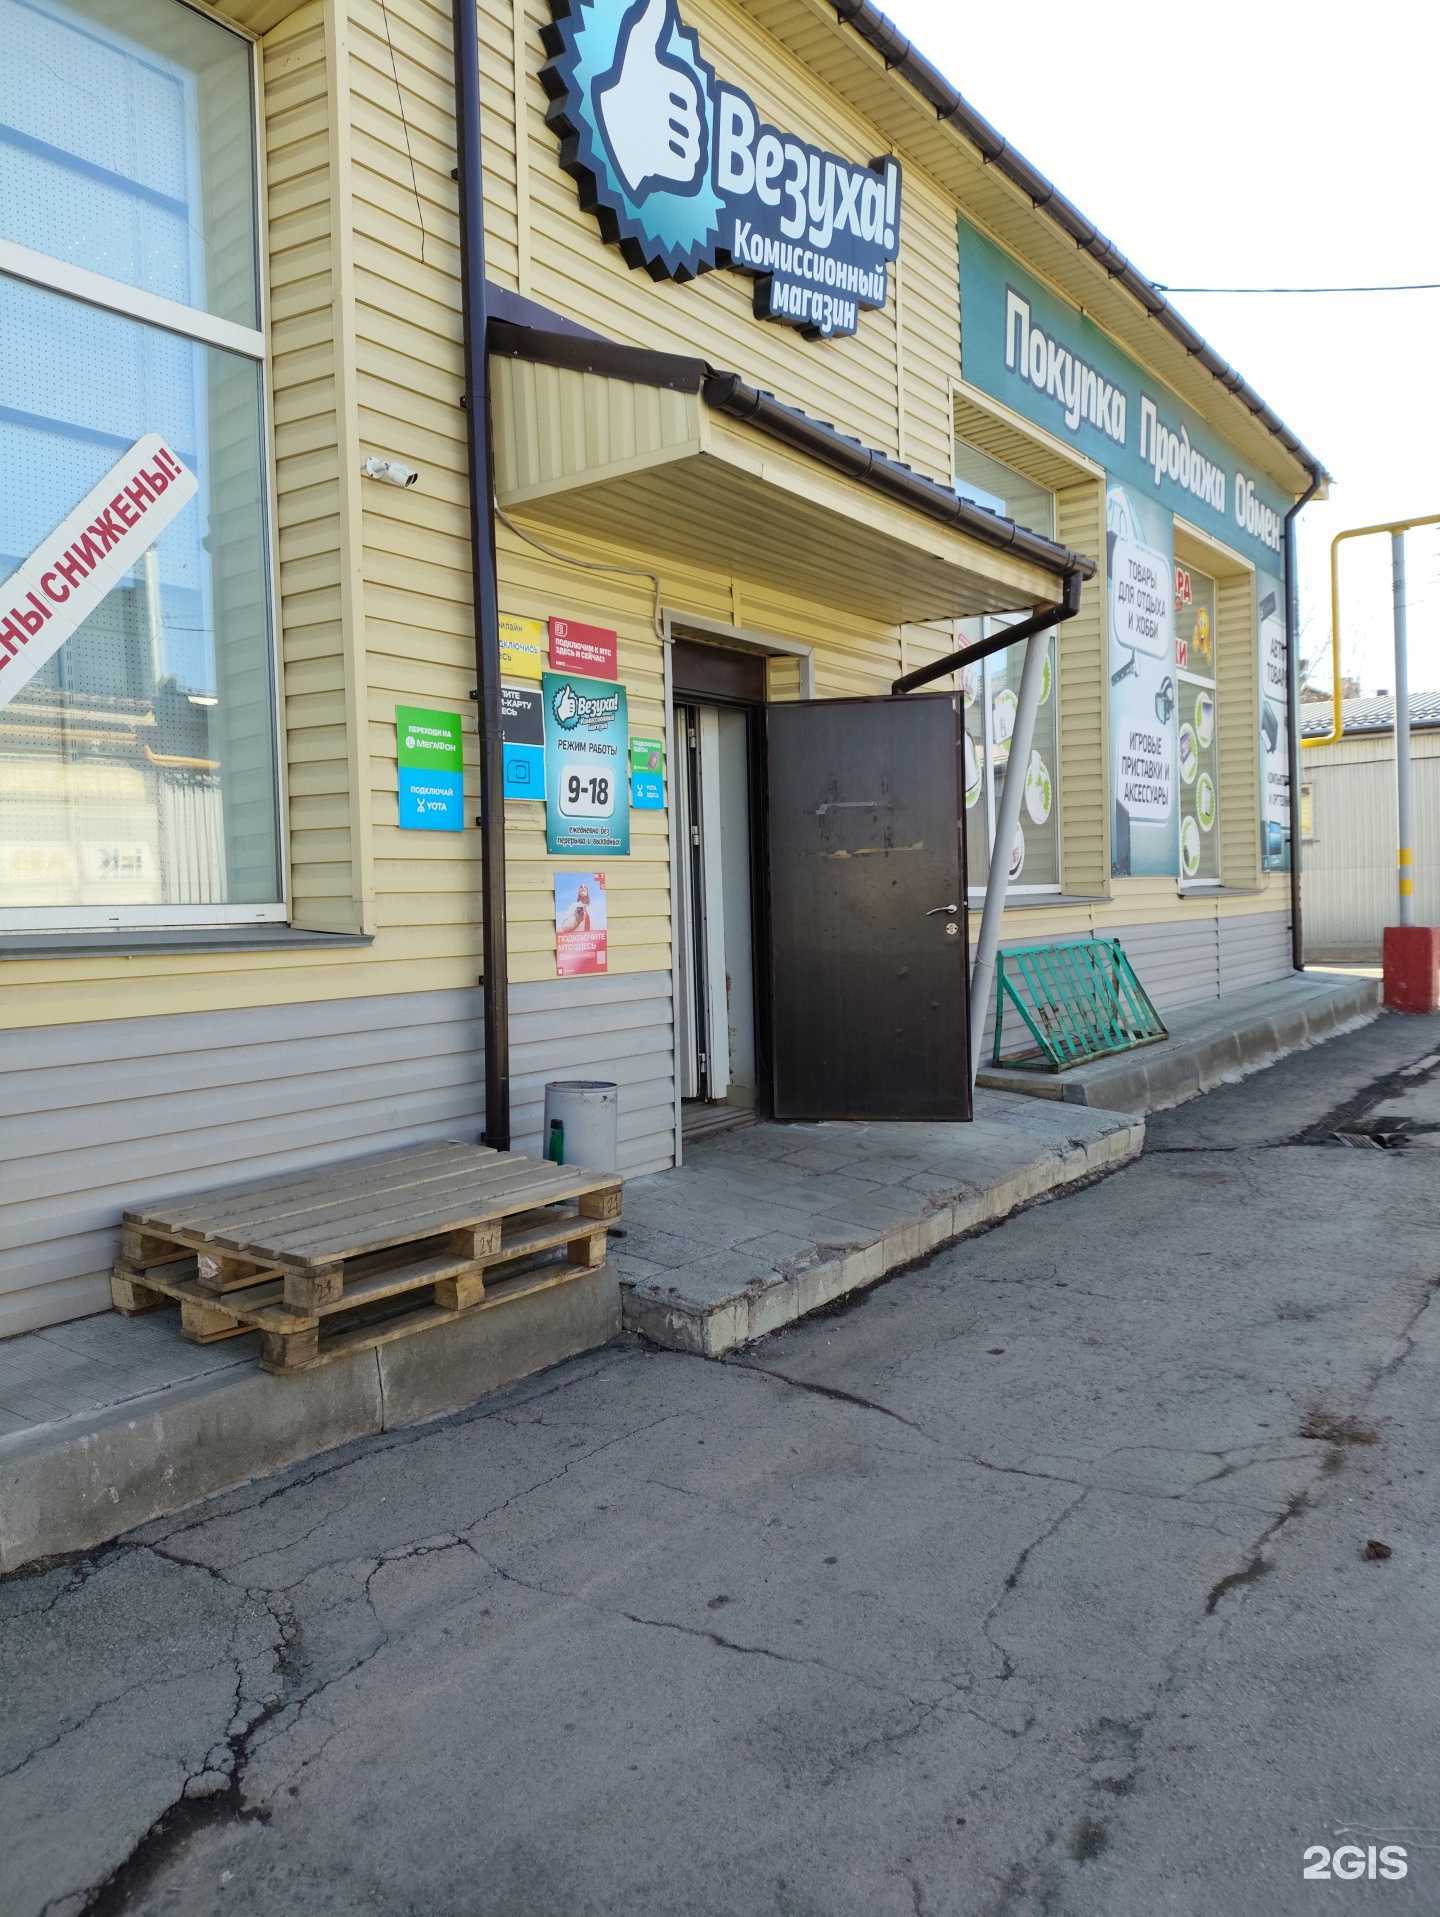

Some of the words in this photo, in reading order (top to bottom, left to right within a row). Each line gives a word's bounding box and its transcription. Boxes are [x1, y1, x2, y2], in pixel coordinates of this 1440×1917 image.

[718, 90, 898, 250] Везуха!
[734, 219, 885, 301] Комиссионный
[773, 281, 856, 334] магазин
[1005, 289, 1127, 443] Покупка
[1140, 395, 1226, 513] Продажа
[1235, 474, 1281, 552] Обмен
[40, 447, 182, 604] СНИЖЕНЫ!
[1128, 558, 1158, 590] ТОВАРЫ
[1118, 581, 1135, 605] ДЛЯ
[1137, 589, 1167, 619] ОТДЫХА
[1128, 611, 1134, 630] И
[1136, 614, 1160, 640] ХОББИ
[501, 708, 518, 717] ЕСЬ
[577, 693, 618, 717] Везуха!
[557, 739, 586, 752] РЕЖИМ
[589, 742, 618, 755] РАБОТЫ
[1129, 731, 1162, 755] ИГРОВЫЕ
[1122, 755, 1163, 780] ПРИСТАВКИ
[568, 775, 609, 805] 9-18
[1124, 782, 1169, 806] АКСЕССУАРЫ
